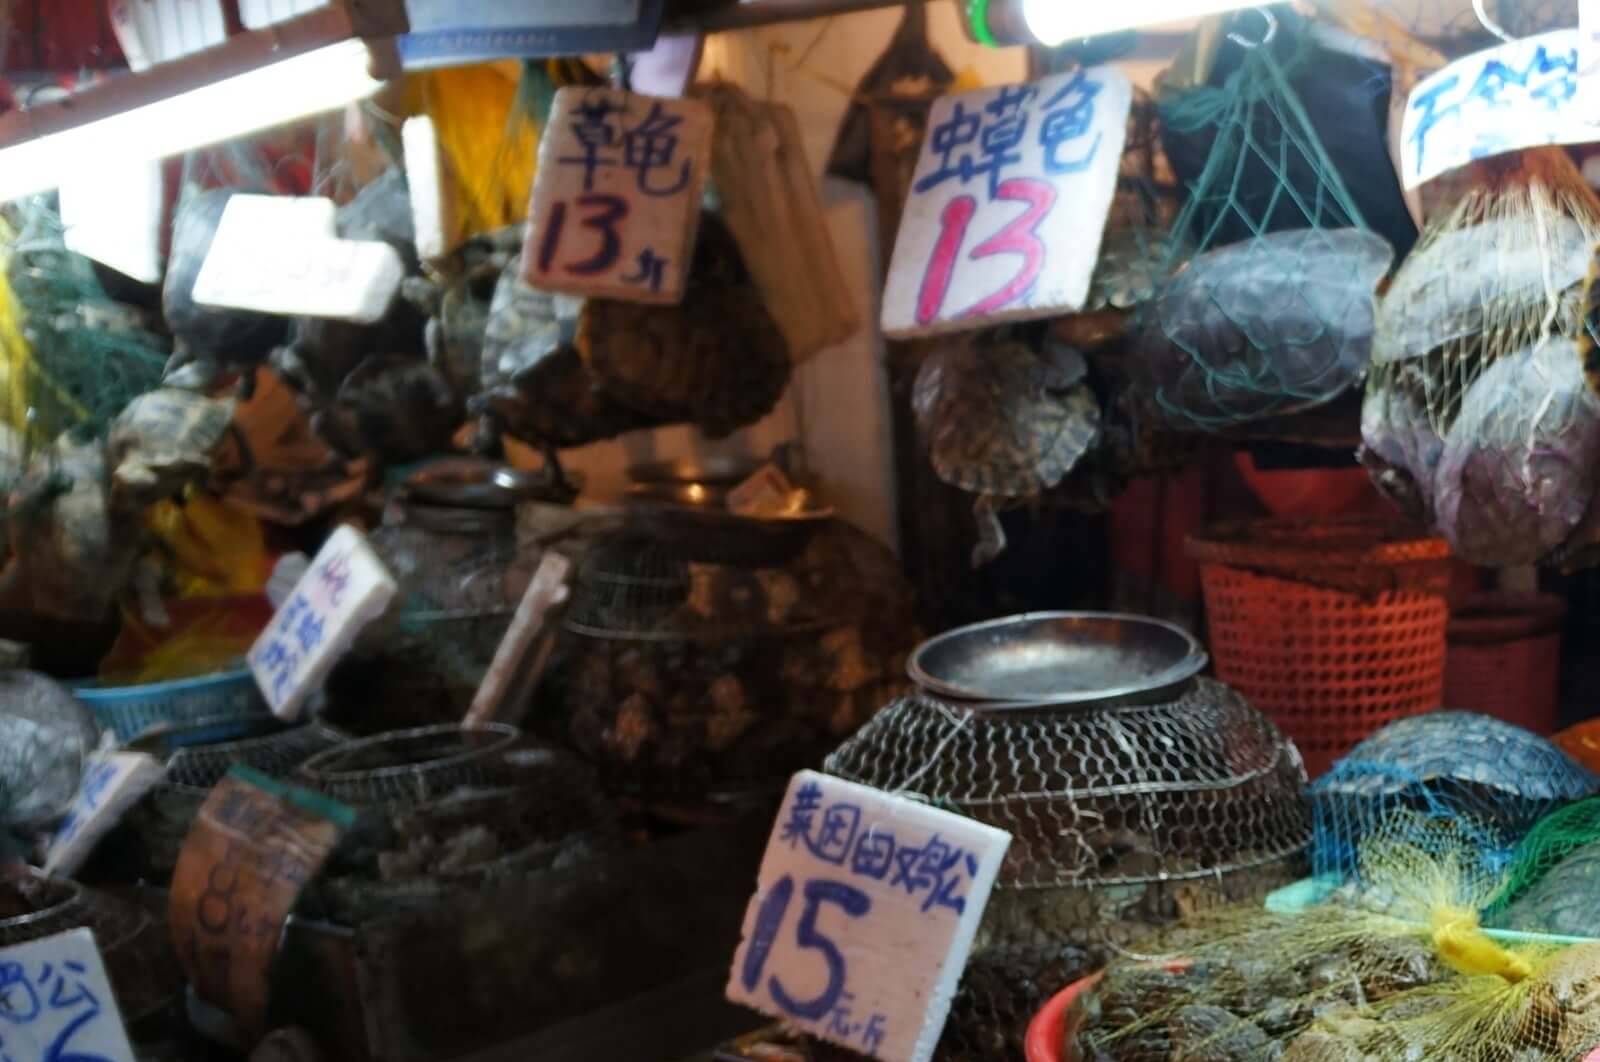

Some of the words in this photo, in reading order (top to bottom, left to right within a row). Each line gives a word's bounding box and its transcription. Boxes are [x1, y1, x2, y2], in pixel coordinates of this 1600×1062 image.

[535, 193, 630, 276] 13
[914, 178, 1056, 328] 13
[742, 873, 871, 1021] 15
